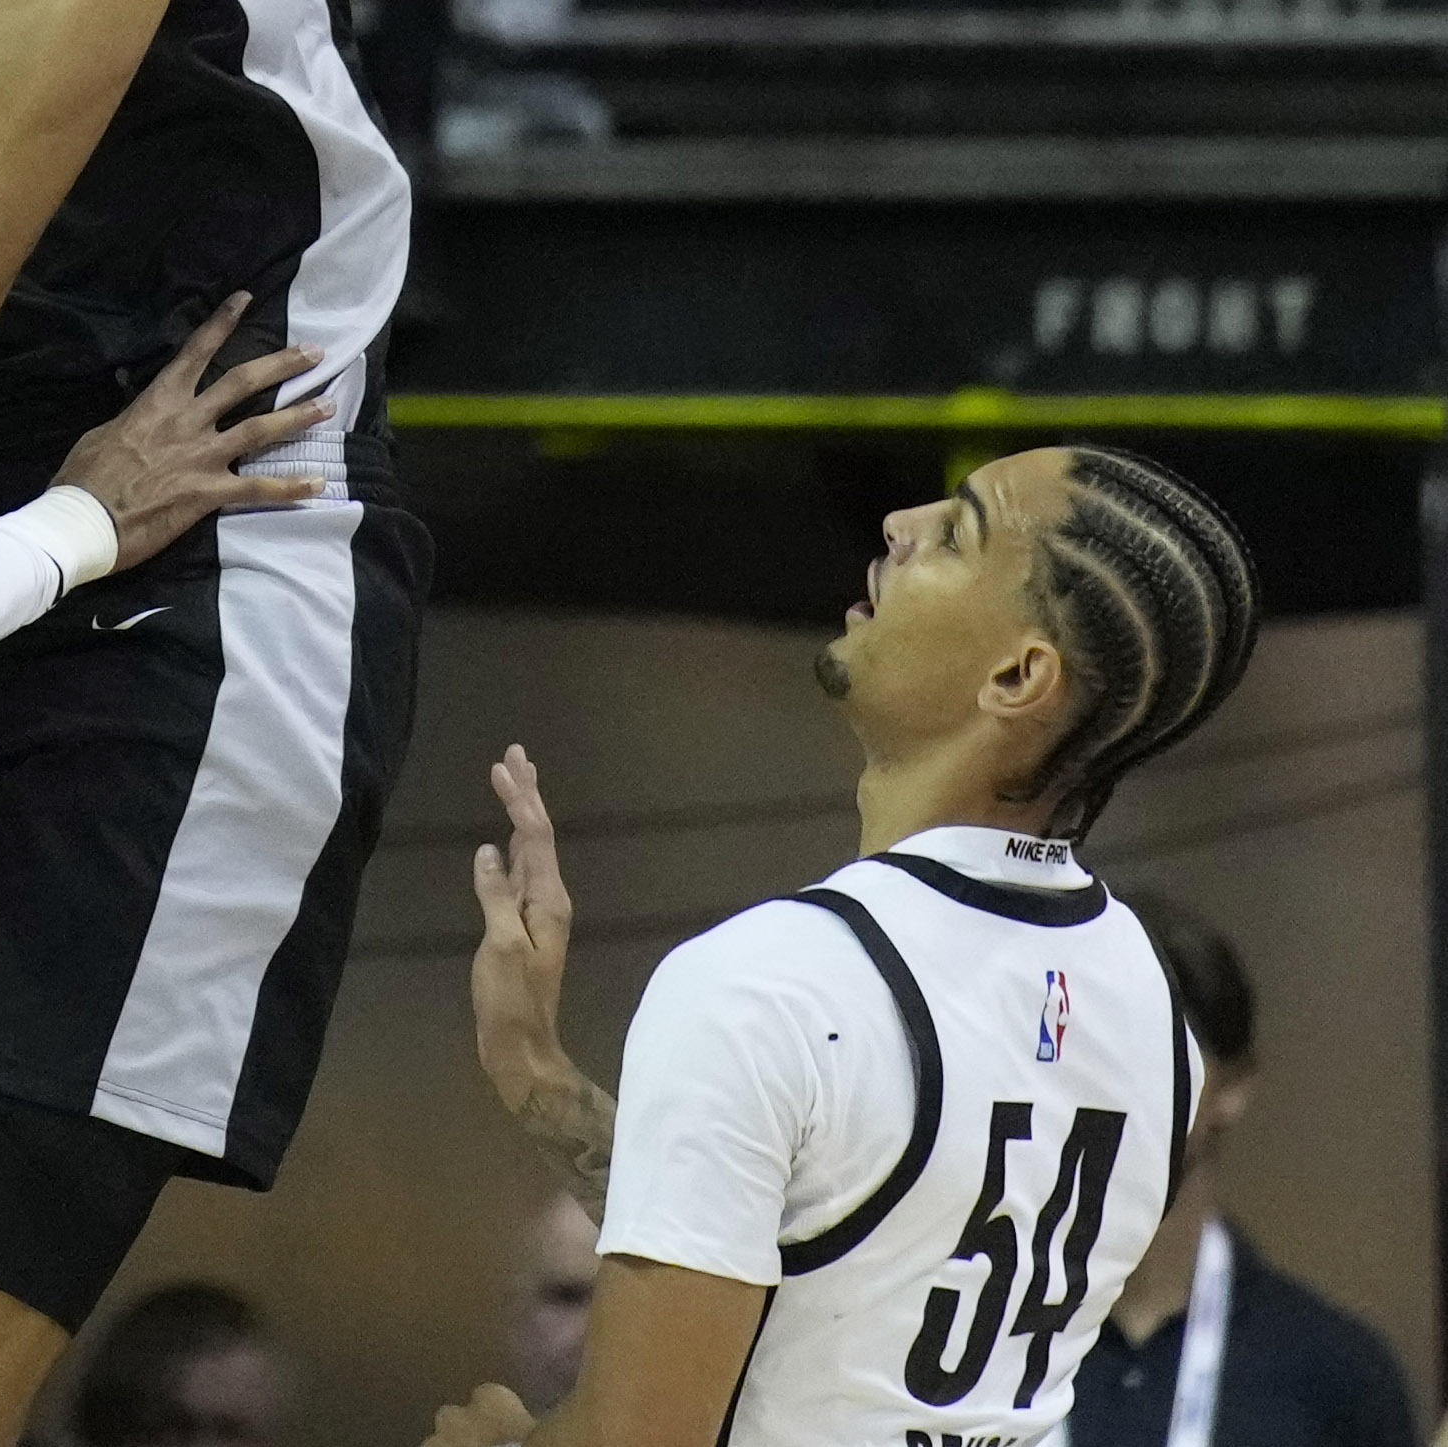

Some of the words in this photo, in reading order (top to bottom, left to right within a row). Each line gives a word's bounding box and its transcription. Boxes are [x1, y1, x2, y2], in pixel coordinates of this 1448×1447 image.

[1033, 274, 1318, 355] FRONT
[1005, 837, 1046, 863] NIKE
[904, 1101, 1127, 1410] 54
